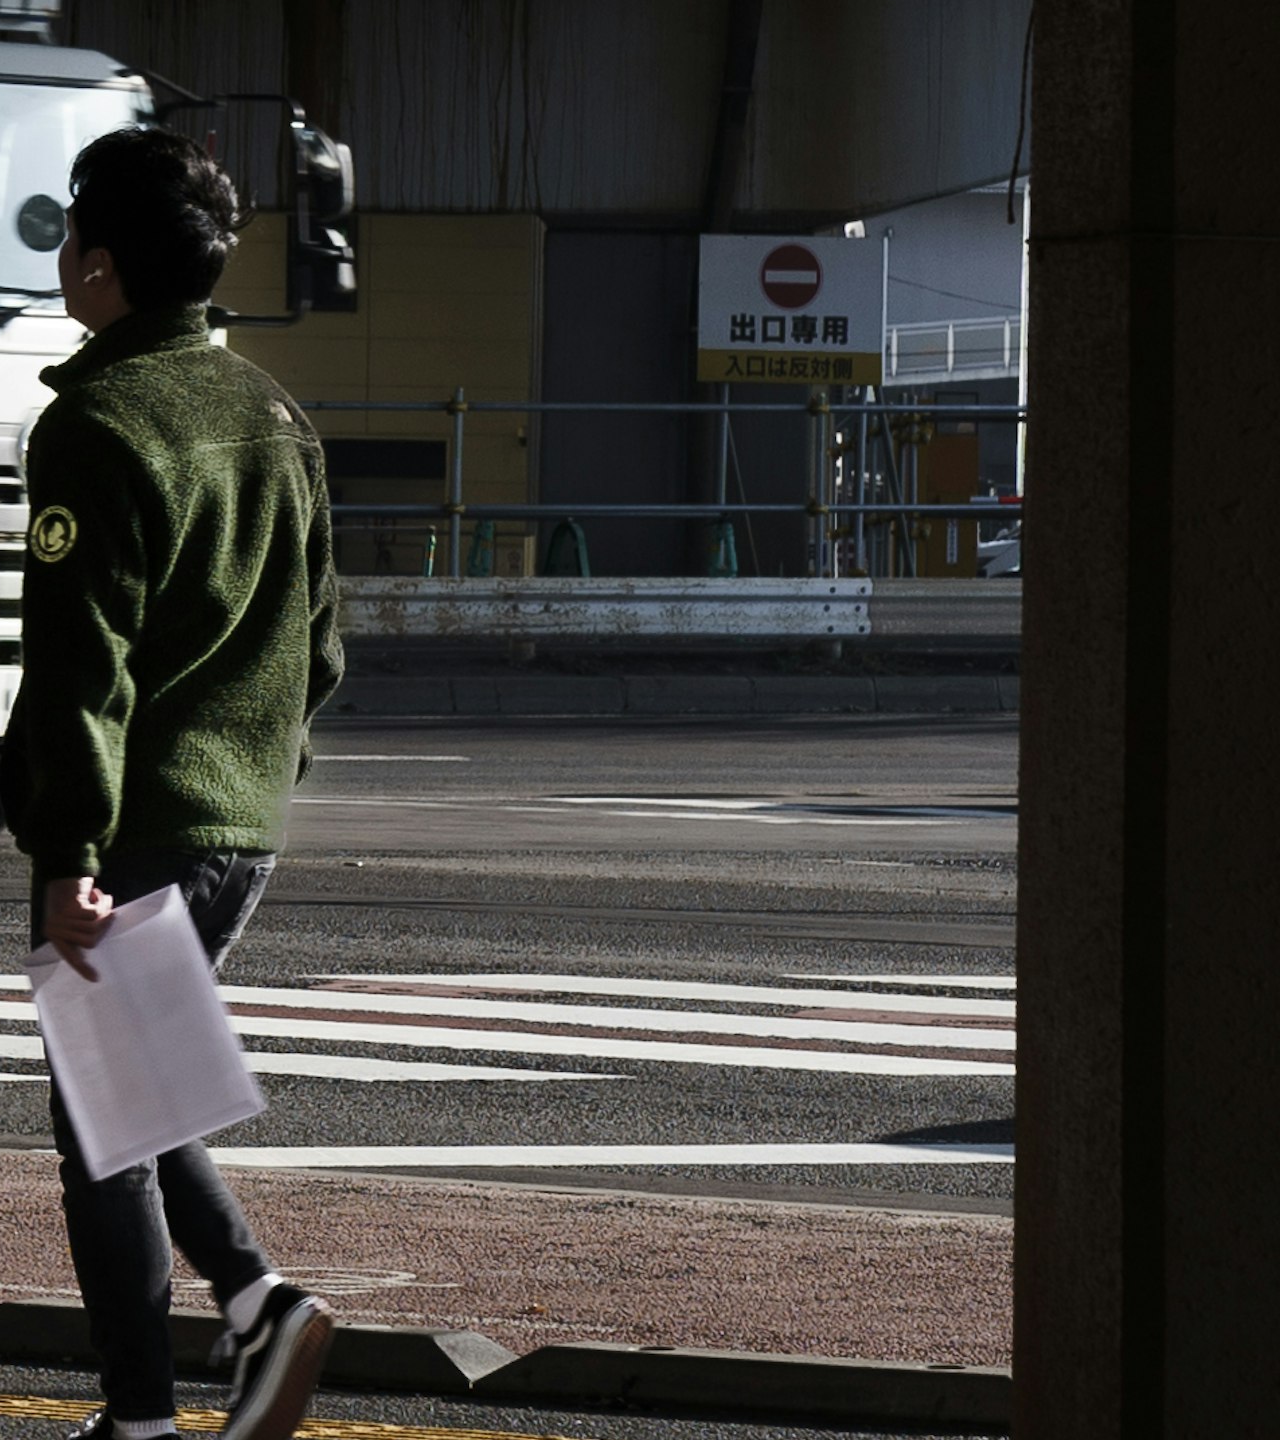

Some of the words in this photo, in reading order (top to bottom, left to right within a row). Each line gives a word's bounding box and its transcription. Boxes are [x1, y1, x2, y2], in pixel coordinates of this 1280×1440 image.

[730, 314, 849, 344] 出口専用
[726, 356, 853, 380] 入口は反対側
